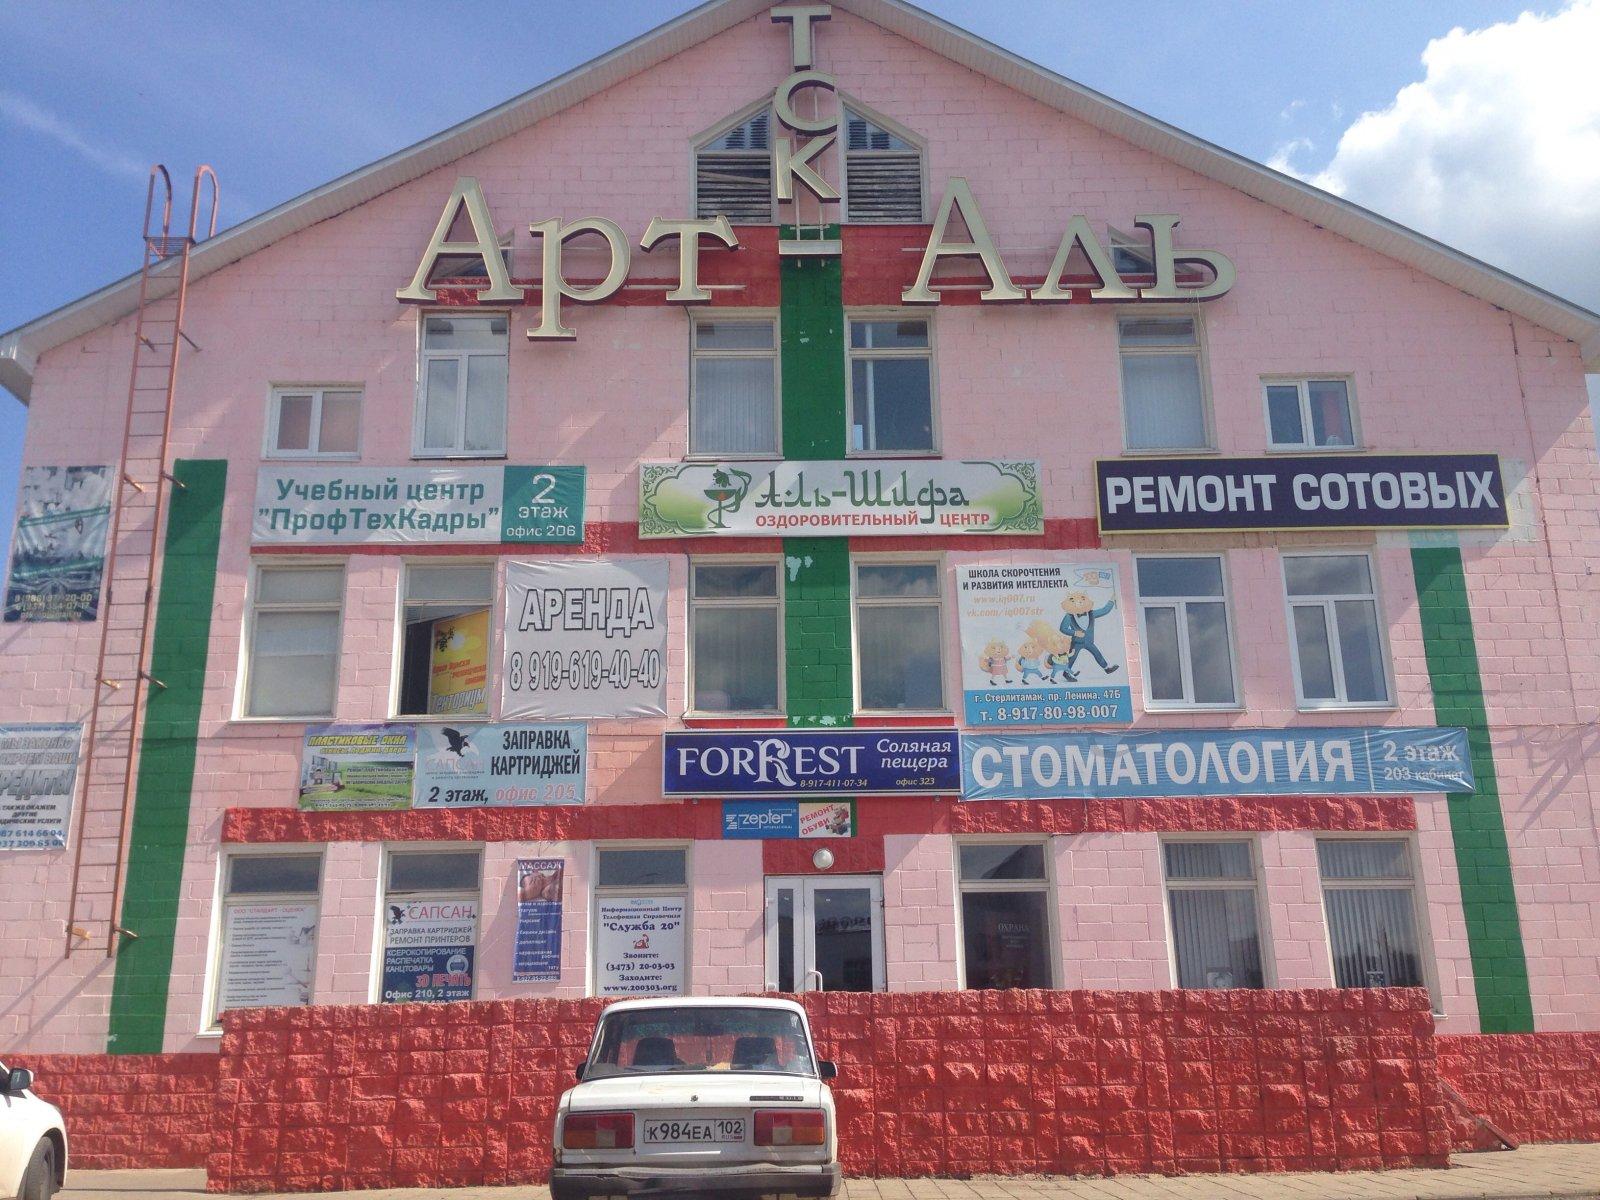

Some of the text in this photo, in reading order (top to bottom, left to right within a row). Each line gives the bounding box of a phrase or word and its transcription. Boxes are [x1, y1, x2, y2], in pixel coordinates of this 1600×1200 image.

[771, 5, 842, 203] ТСК
[276, 477, 484, 505] Учебный центр
[532, 473, 556, 504] 2
[1106, 471, 1499, 514] РЕМОНТ СОТОВЫХ
[518, 506, 569, 519] этаж
[756, 511, 990, 528] ОЗДОРОВИТЕЛЬНЫЙ ЦЕНТР
[258, 507, 499, 535] "ПрофТехКадры"
[506, 525, 576, 538] офис 206
[968, 568, 1061, 579] ШКОЛА СКОРОЧТЕНИЯ
[963, 580, 1068, 590] И РАЗВИТИЯ ИНТЕЛЛЕКТА
[519, 587, 655, 638] АРЕНДА
[510, 649, 660, 691] 8 919-619-40-40
[1048, 693, 1062, 703] пр.
[1103, 690, 1121, 699] 47Б
[980, 705, 1118, 721] т. 8-917-80-98-007
[307, 734, 407, 746] ПЛАСТИКОВЫЕ ОКНА
[503, 730, 571, 750] ЗАПРАВКА
[877, 739, 952, 753] Соляная
[1383, 740, 1460, 762] 2 этаж
[491, 750, 580, 778] КАРТРИДЖЕЙ
[677, 738, 865, 787] FORREST
[881, 755, 948, 772] пещера
[971, 740, 1355, 788] СТОМАТОЛОГИЯ
[1384, 767, 1464, 780] 203 кабинет
[800, 779, 868, 788] 8-917-411-07-34
[895, 777, 935, 787] офис 323
[428, 784, 576, 804] 2 этаж, офис 205
[739, 809, 793, 829] zepter
[800, 804, 834, 824] РЕМОНТ
[801, 818, 830, 835] ОБУВИ
[408, 905, 472, 920] САПСАН
[390, 926, 472, 936] ЗАПРАВКА КАРТРИДЖЕЙ
[603, 920, 680, 933] "Служба 20"
[390, 935, 471, 945] РЕМОНТ ПРИНТЕРОВ
[387, 948, 467, 957] КСЕРОКОПИРОВАНИЕ
[386, 957, 434, 965] РАСПЕЧАТКА
[606, 962, 635, 971] (3473)
[385, 965, 434, 974] КАНЦТОВАРЫ
[432, 973, 472, 987] ПЕЧАТЬ
[385, 989, 469, 1000] Офис 210, 2 этаж
[603, 984, 678, 992] www.200303.org
[716, 1121, 742, 1135] 102
